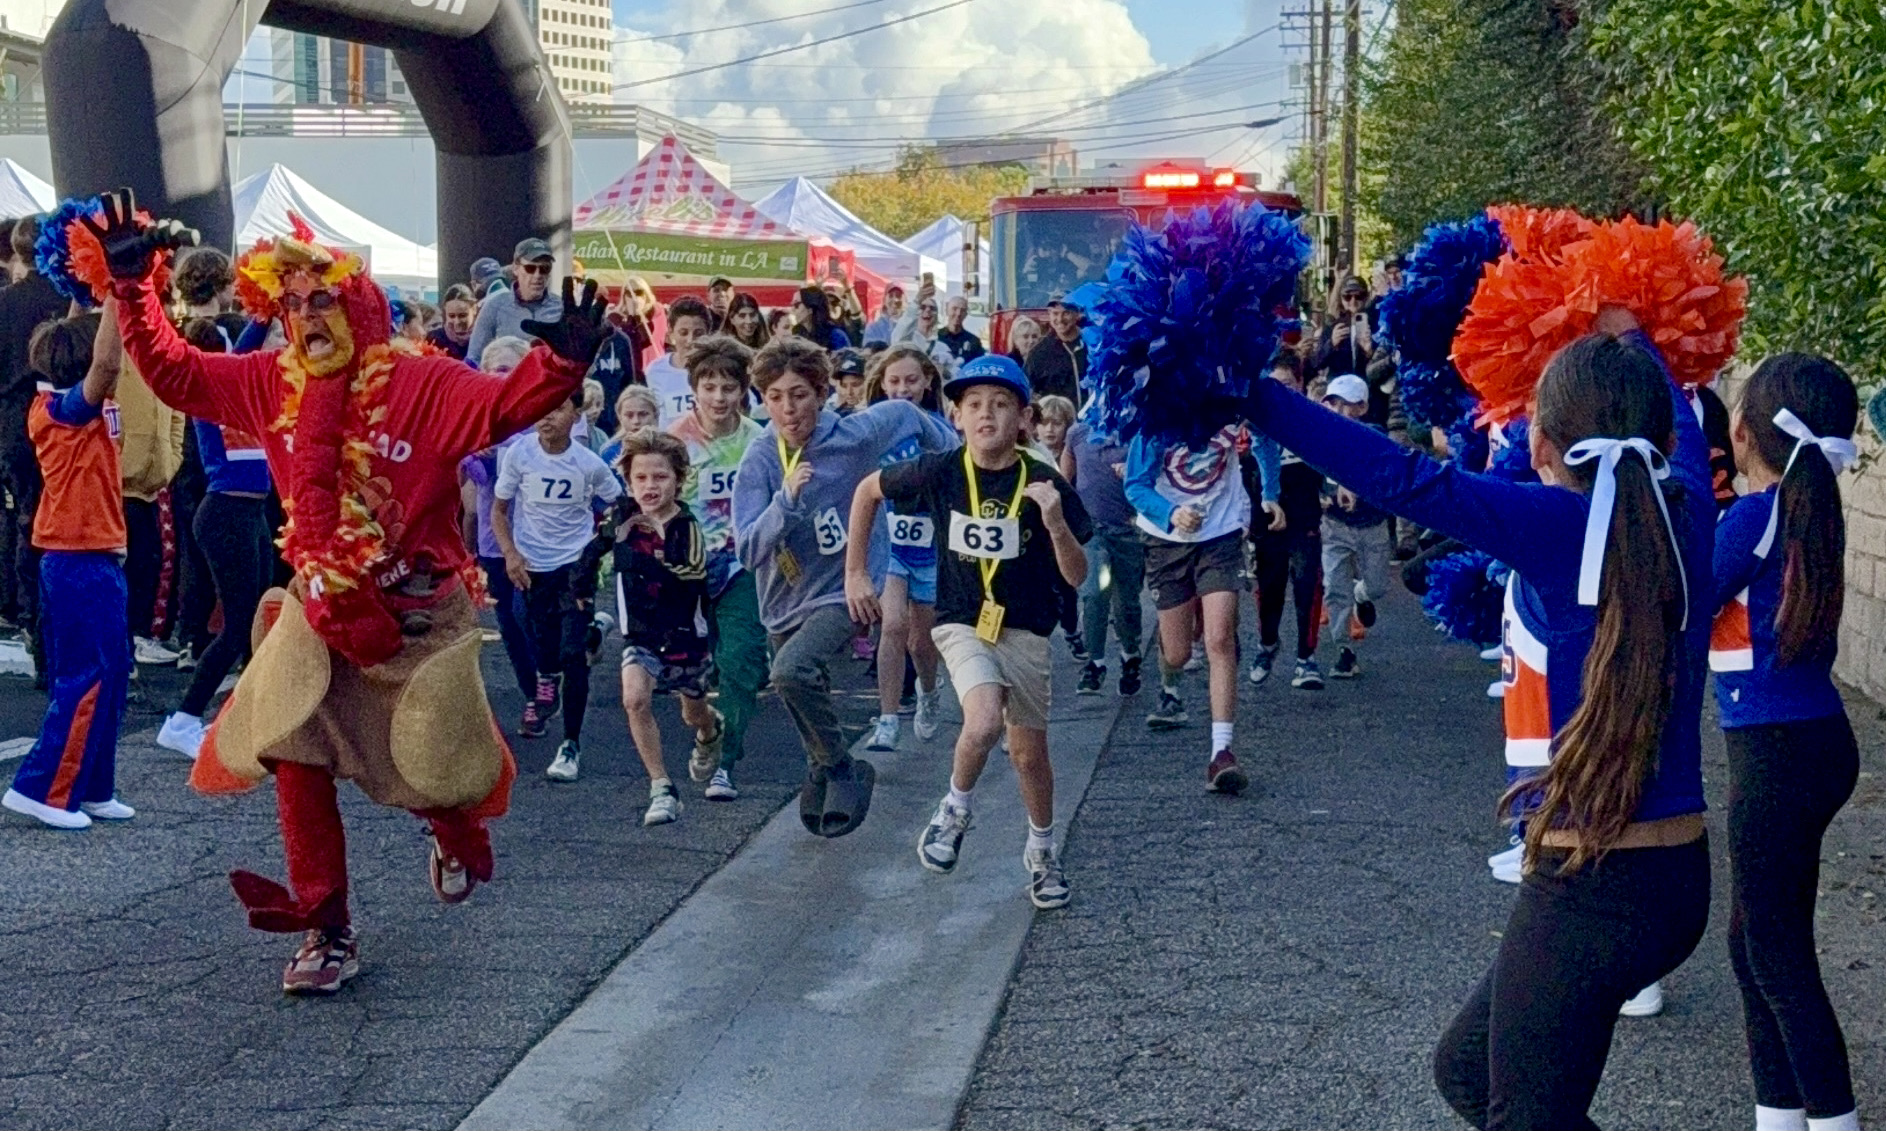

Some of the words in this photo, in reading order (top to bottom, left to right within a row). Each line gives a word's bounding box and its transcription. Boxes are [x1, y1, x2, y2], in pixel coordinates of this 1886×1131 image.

[623, 243, 714, 266] Restaurant
[719, 249, 736, 267] in
[740, 251, 769, 271] LA
[672, 394, 697, 413] 75
[541, 477, 573, 499] 72
[894, 520, 924, 541] 86
[963, 523, 1004, 552] 63
